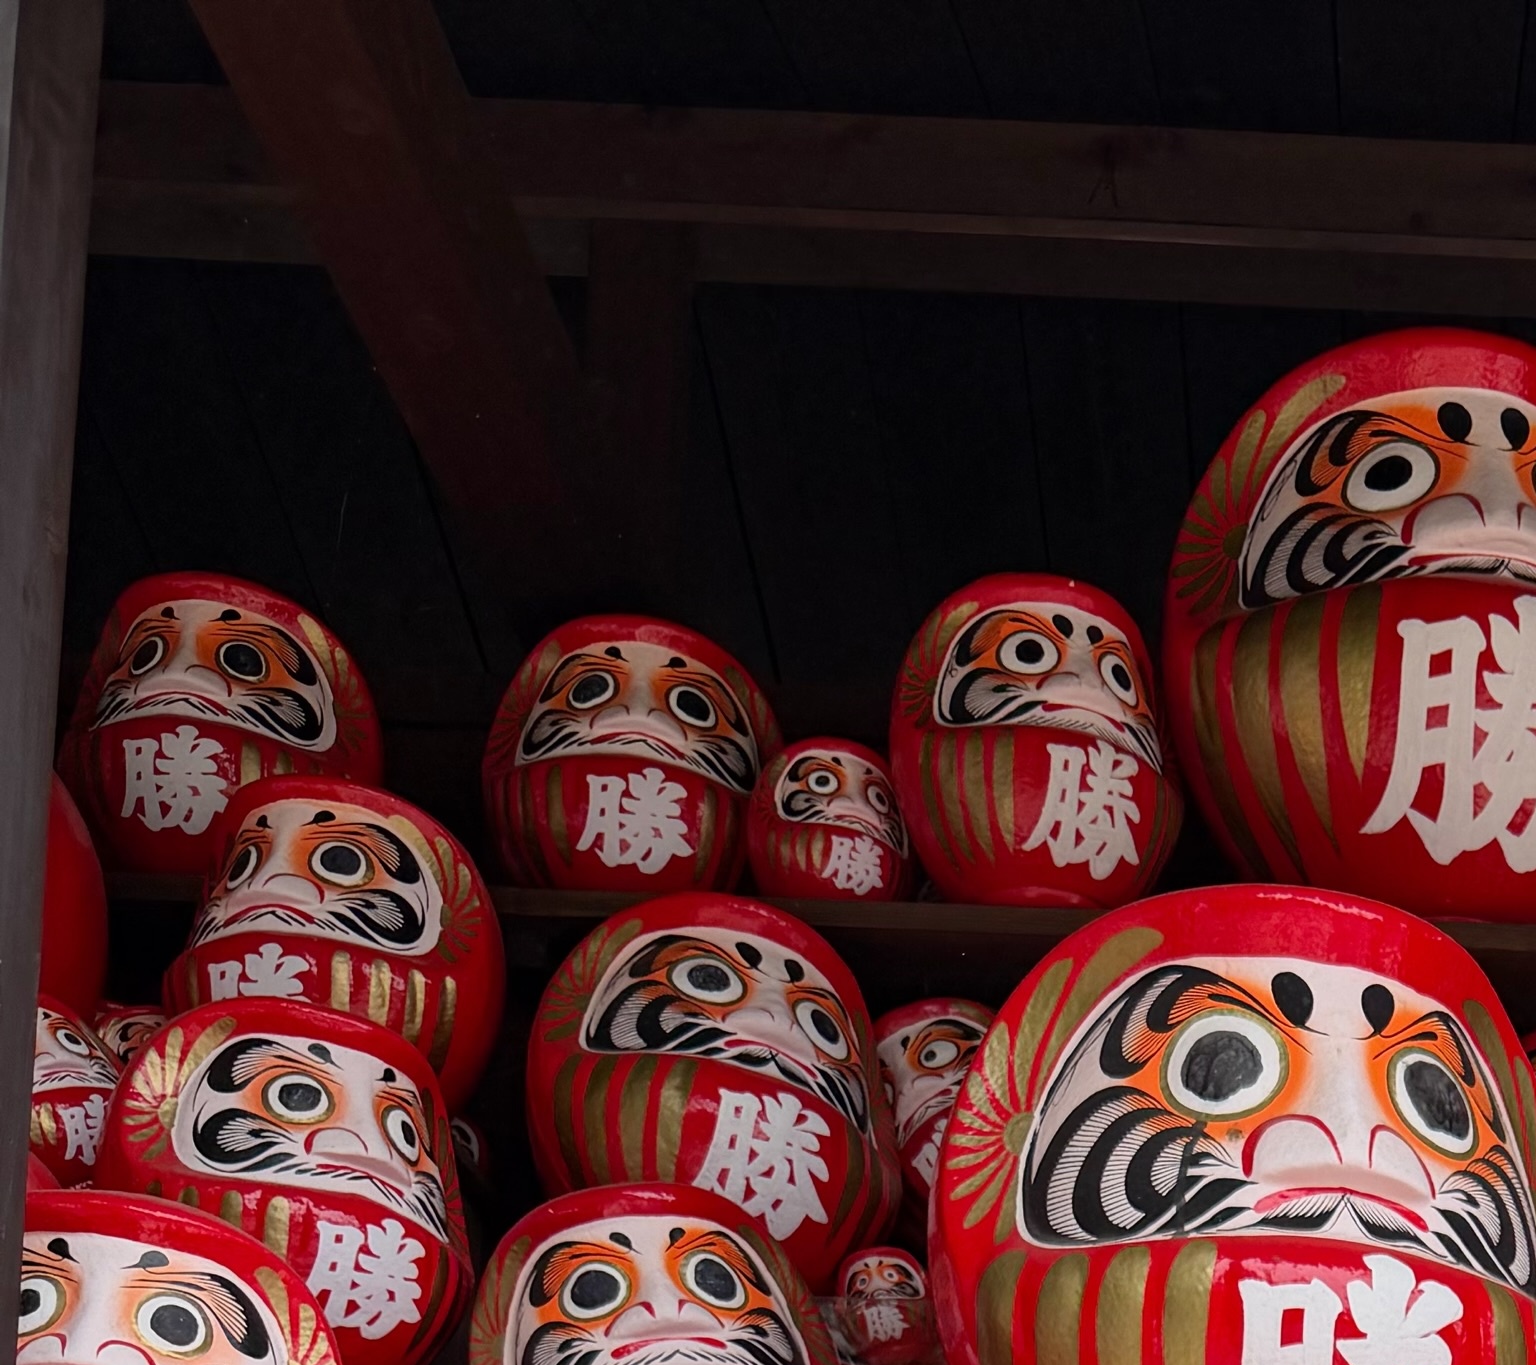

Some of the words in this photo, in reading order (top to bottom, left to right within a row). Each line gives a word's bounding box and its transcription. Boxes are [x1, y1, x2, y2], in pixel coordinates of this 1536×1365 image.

[120, 725, 231, 834] 勝
[576, 767, 697, 874] 勝
[1021, 740, 1142, 880] 勝
[821, 834, 884, 896] 勝
[693, 1087, 831, 1241] 勝
[307, 1218, 425, 1340] 勝
[865, 1304, 910, 1341] 勝
